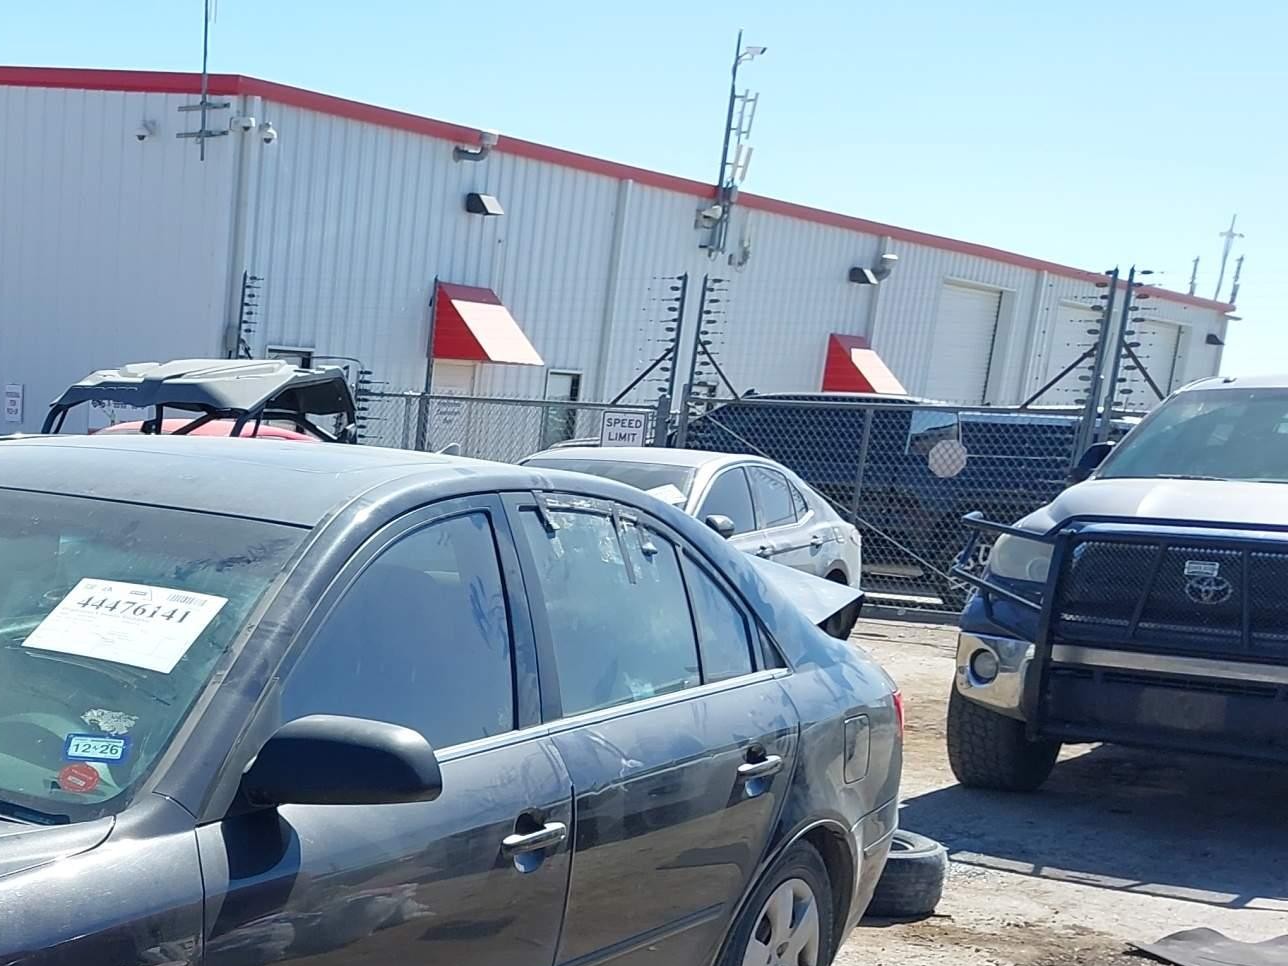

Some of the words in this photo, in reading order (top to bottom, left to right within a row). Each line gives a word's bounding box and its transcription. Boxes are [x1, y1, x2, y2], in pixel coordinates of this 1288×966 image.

[606, 418, 642, 428] SPEED
[608, 432, 638, 442] LIMIT
[77, 595, 192, 623] 44476141
